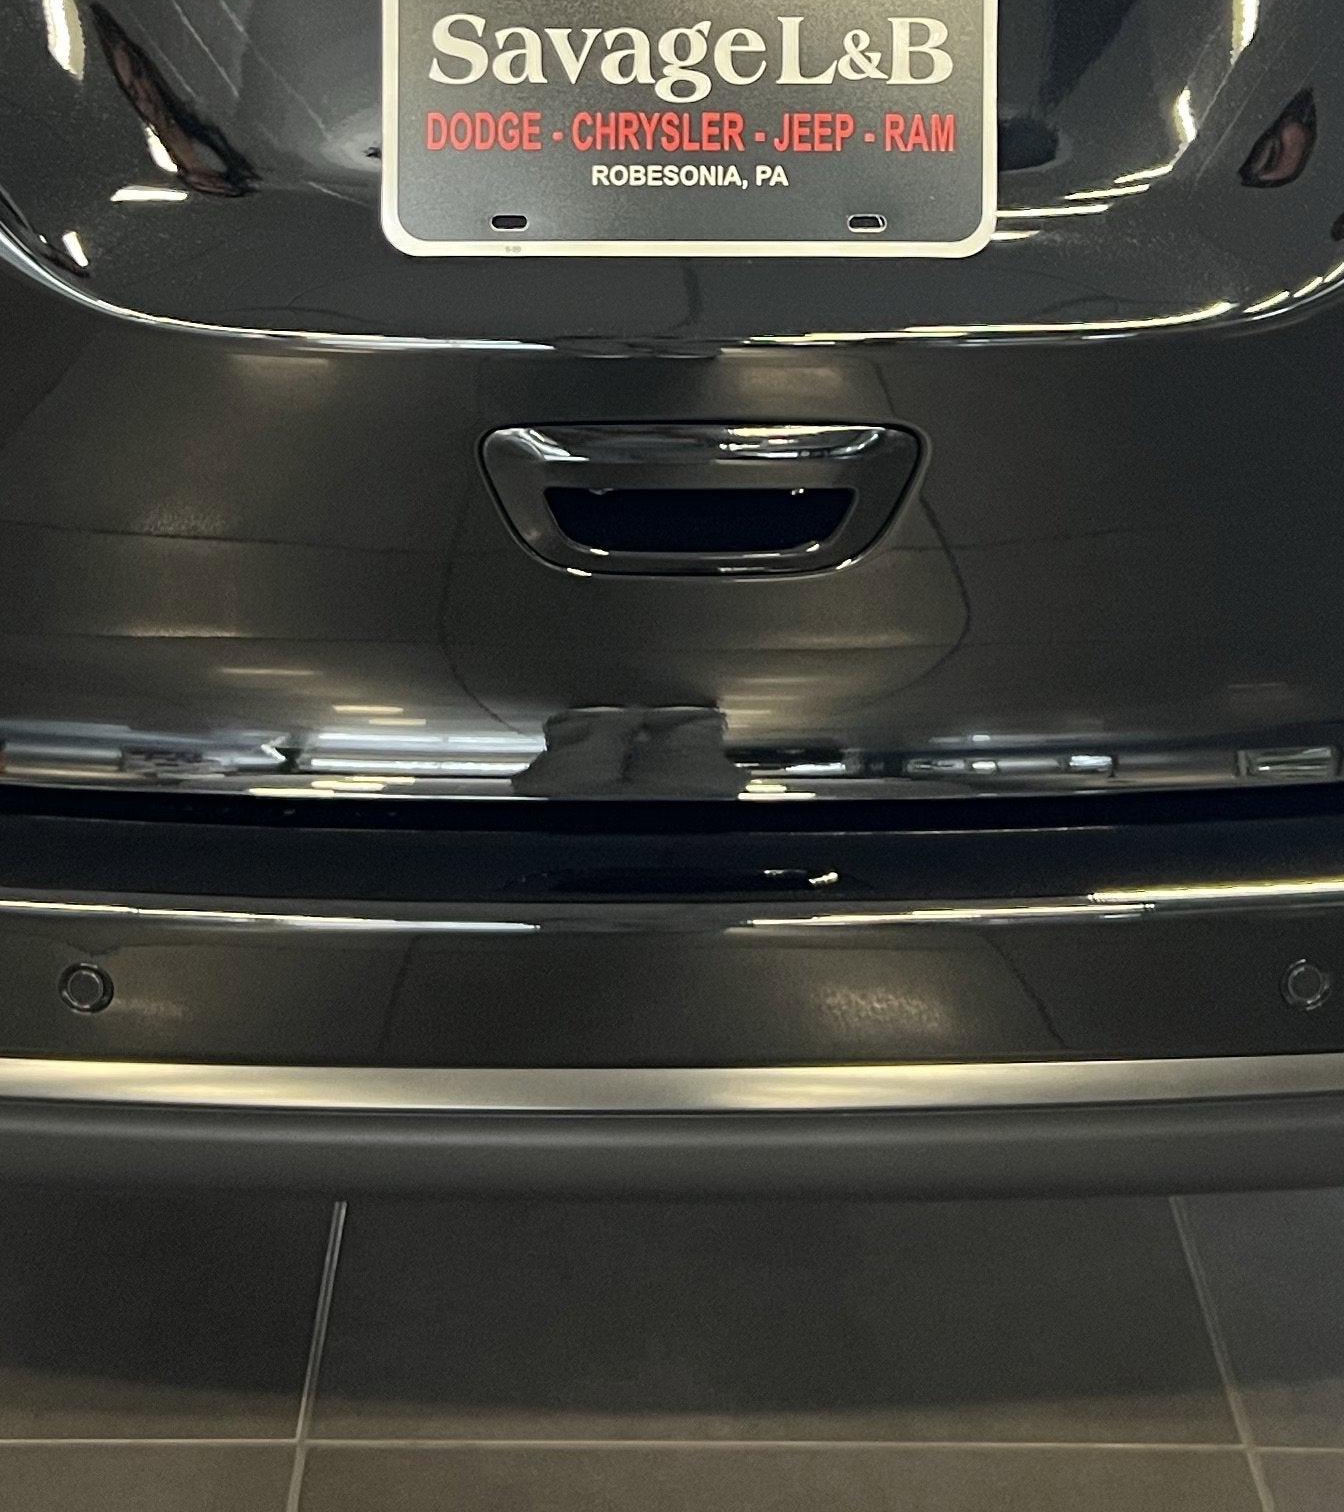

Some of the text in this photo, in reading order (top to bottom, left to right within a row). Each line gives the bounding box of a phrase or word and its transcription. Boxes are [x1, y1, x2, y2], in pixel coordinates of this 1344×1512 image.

[425, 111, 543, 152] DODGE
[571, 111, 745, 153] CHRYSLER
[774, 112, 854, 153] JEEP
[884, 113, 956, 153] RAM
[591, 164, 790, 190] ROBESONIA, PA
